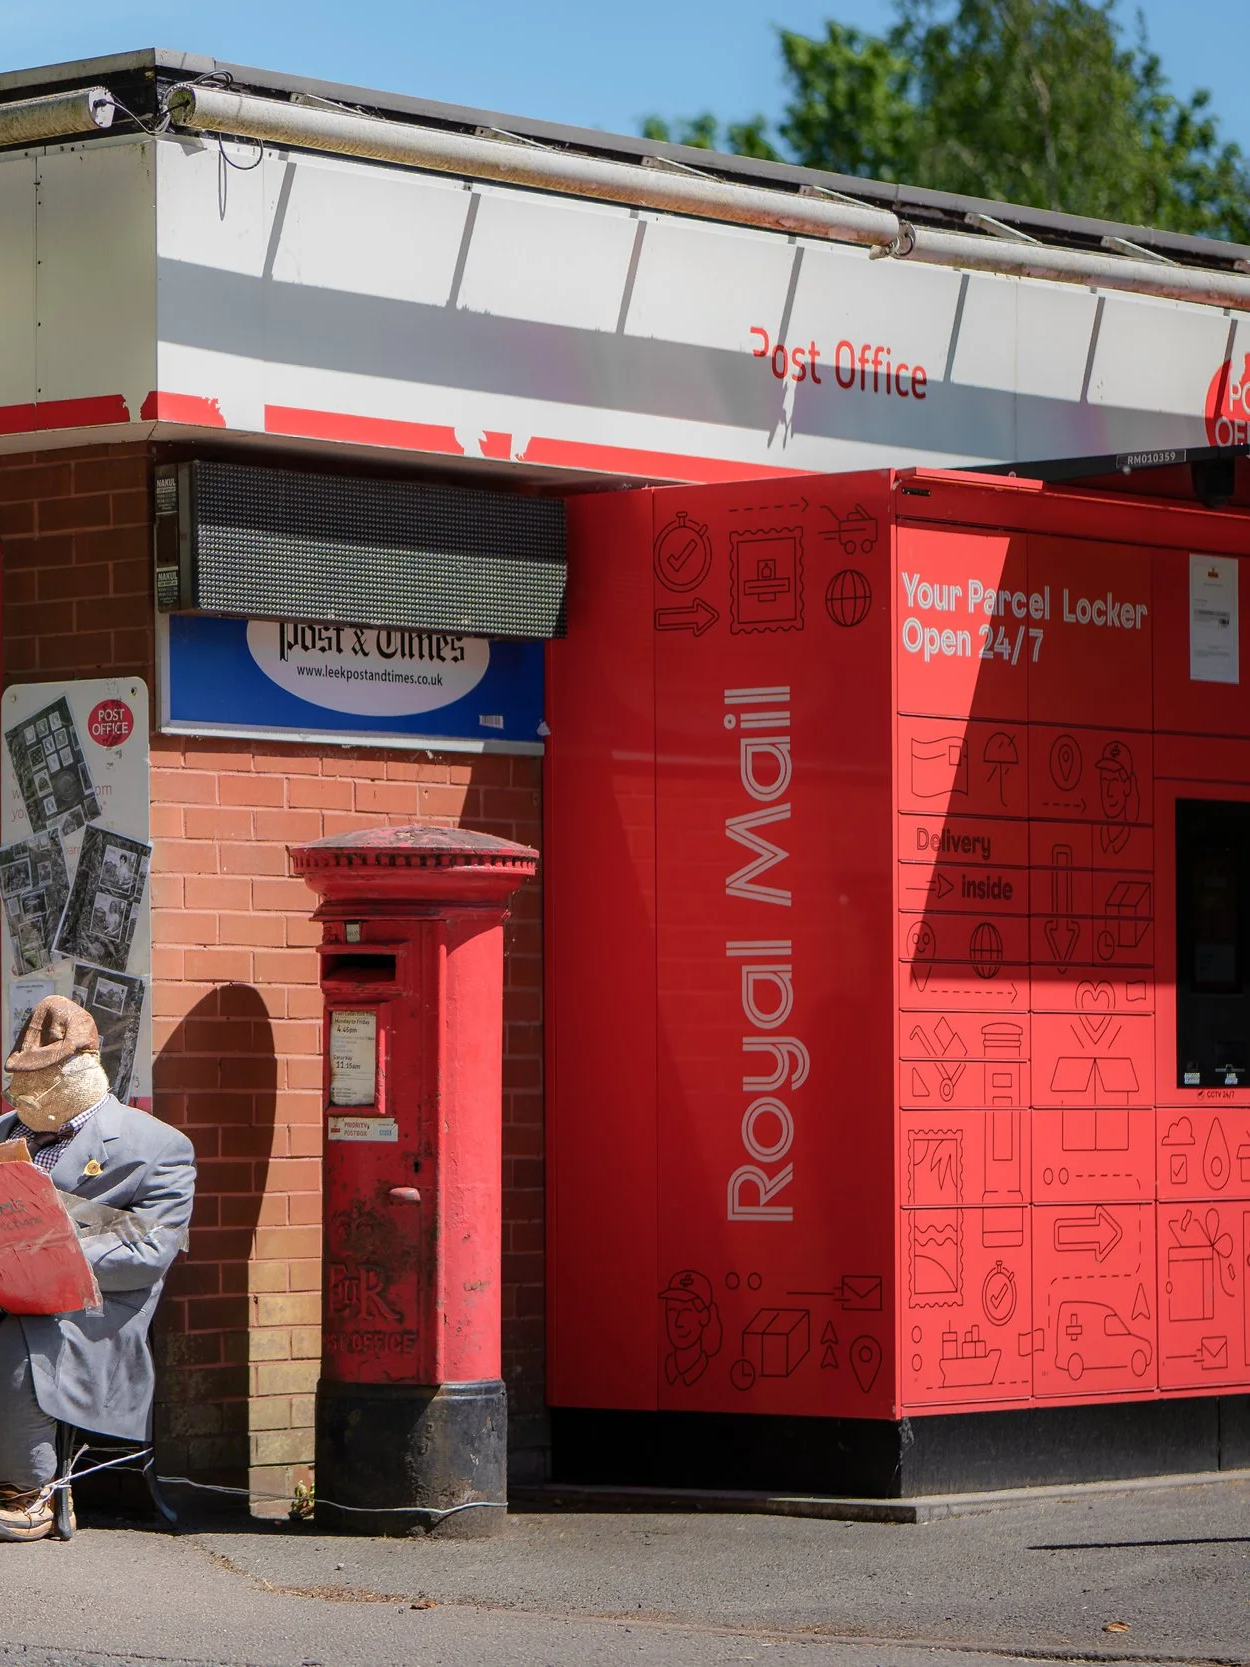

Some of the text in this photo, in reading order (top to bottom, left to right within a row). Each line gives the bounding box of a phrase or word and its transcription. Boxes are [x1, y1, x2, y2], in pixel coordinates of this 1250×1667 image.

[834, 339, 928, 401] Office
[1126, 451, 1177, 466] RM010359
[901, 571, 963, 613] Your
[967, 578, 1050, 621] Parcel
[1062, 588, 1148, 630] Locker
[351, 628, 370, 657] &
[901, 616, 1044, 666] Open 24/7
[296, 664, 444, 687] www.leekpostandtimes.co.uk
[92, 722, 129, 736] OFFICE
[98, 708, 125, 722] POST
[916, 827, 992, 861] Delivery
[961, 873, 1014, 901] inside
[723, 685, 811, 1222] Royal Mail
